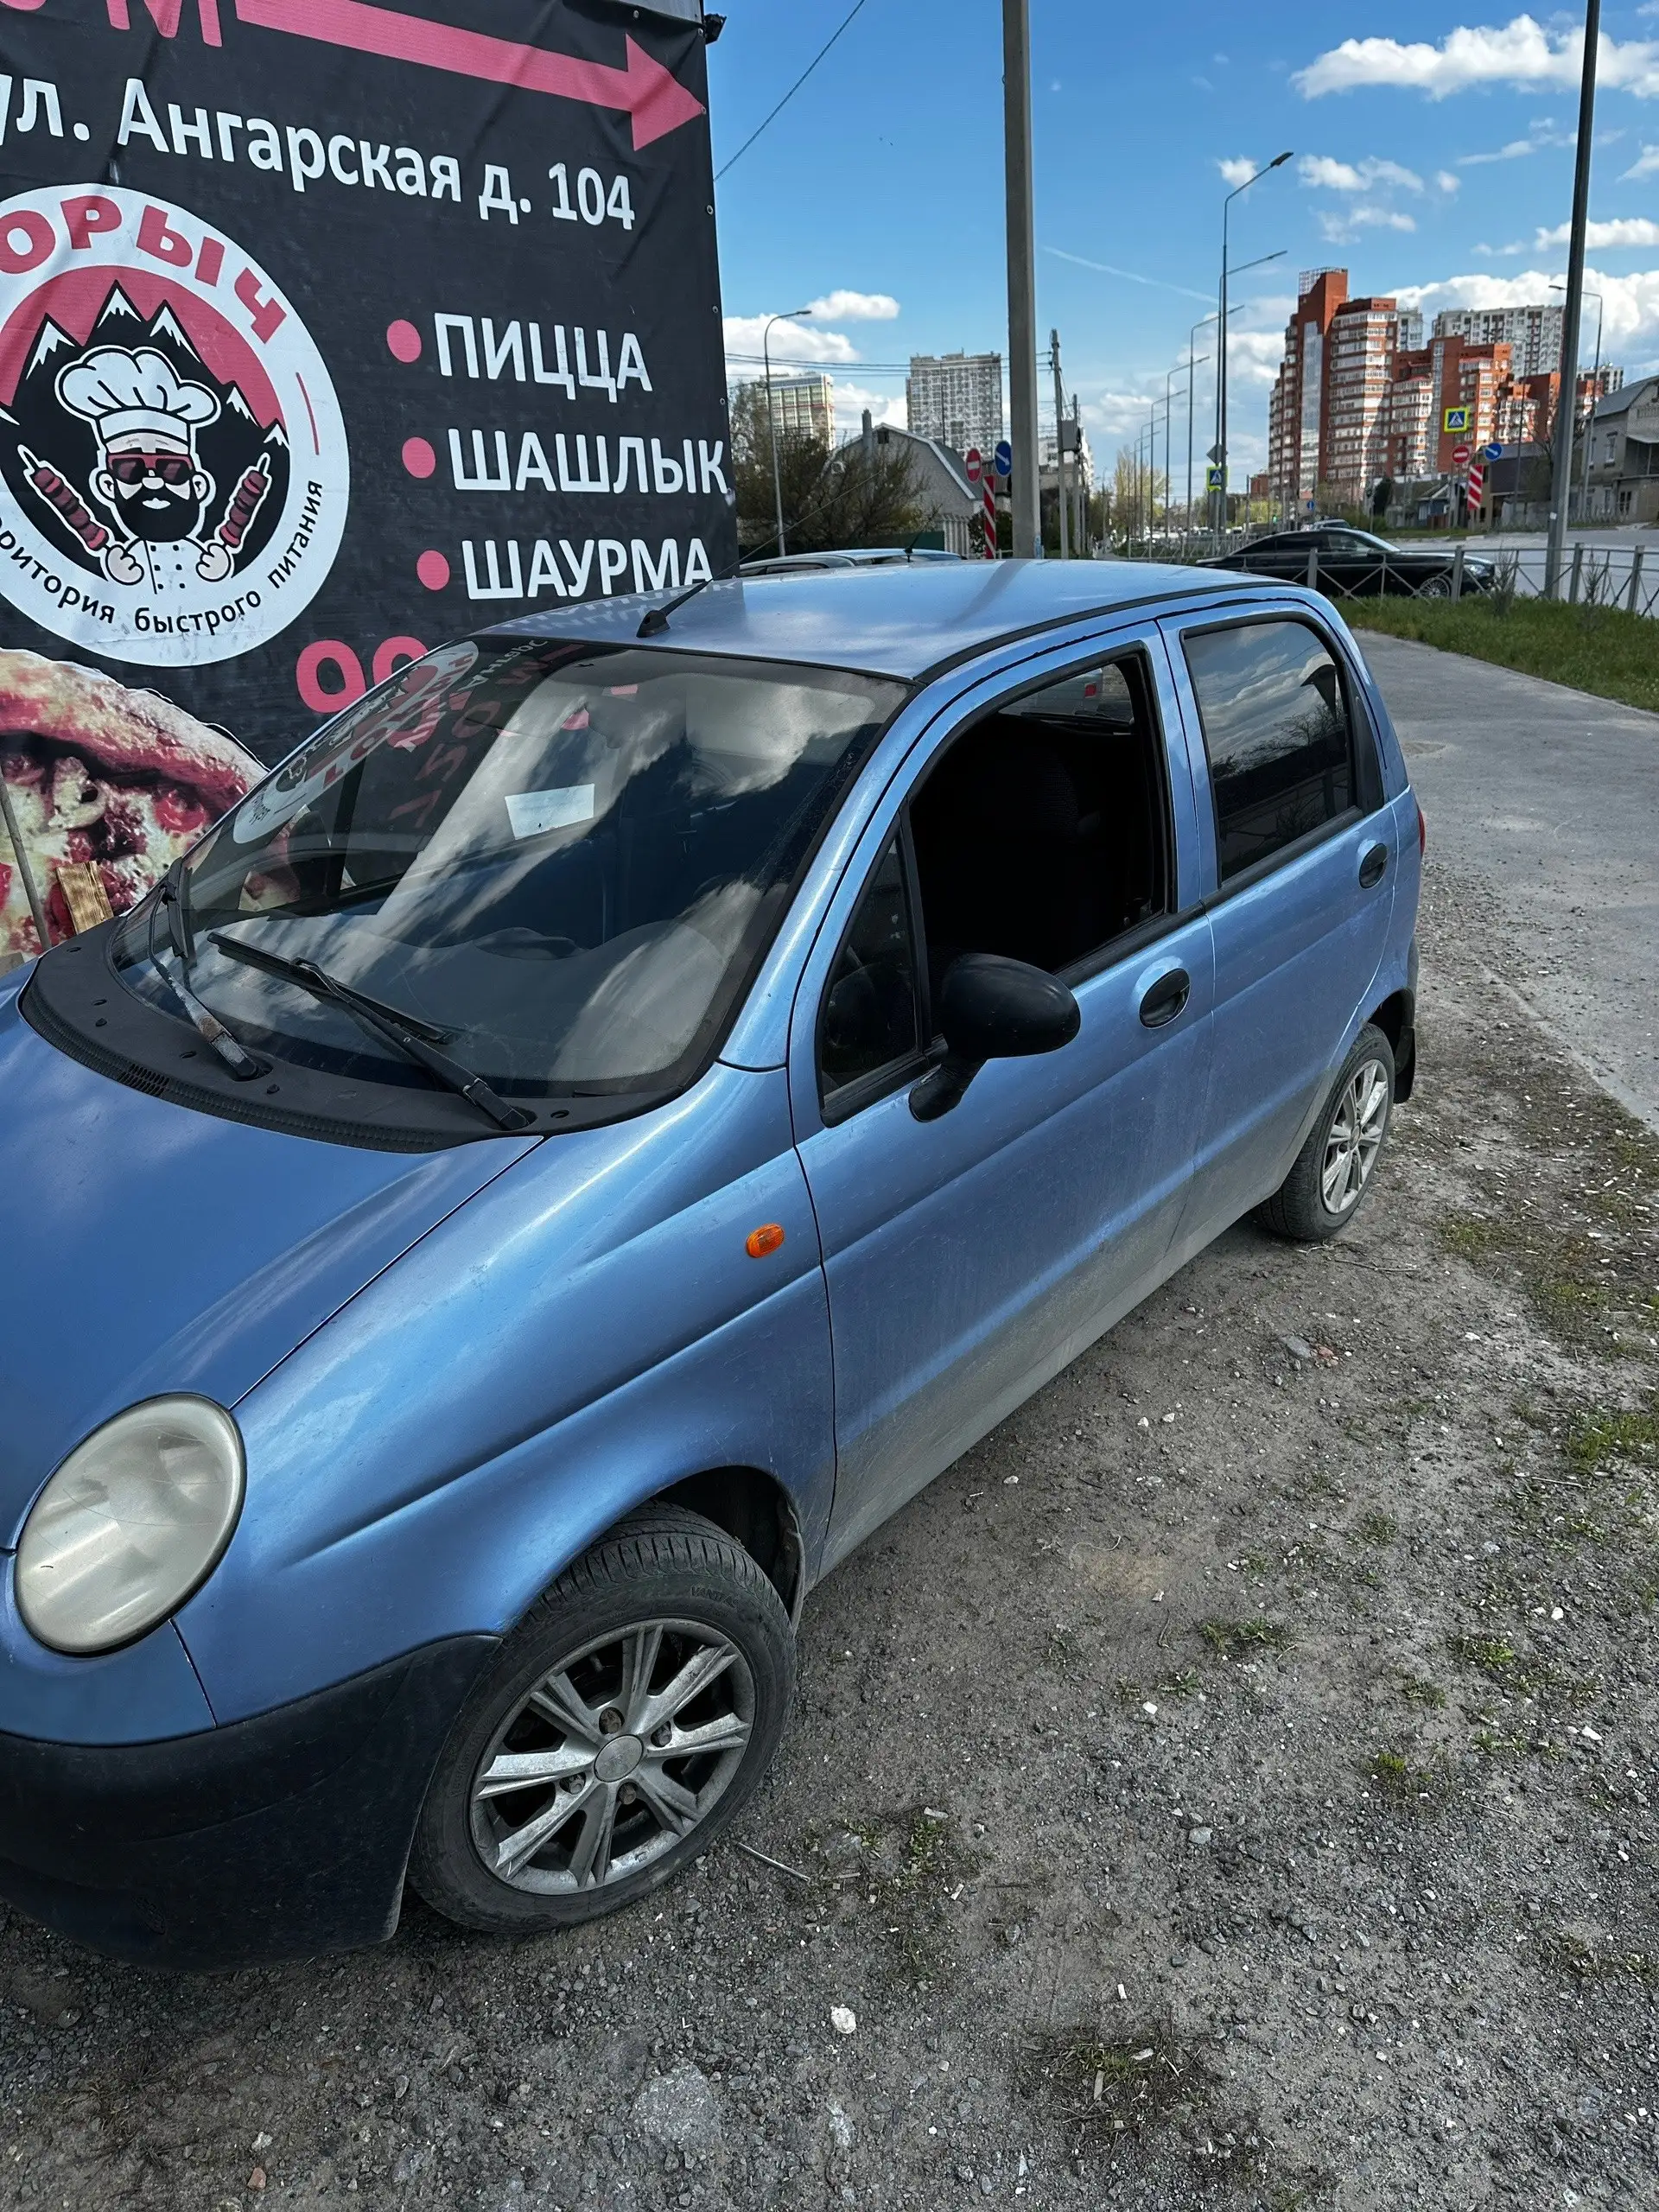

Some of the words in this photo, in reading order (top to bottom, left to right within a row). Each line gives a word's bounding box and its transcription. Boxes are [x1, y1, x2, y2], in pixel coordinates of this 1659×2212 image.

[117, 78, 462, 202] Ангарская
[478, 163, 531, 225] д.
[548, 162, 635, 231] 104
[434, 312, 653, 404] ПИЦЦА
[448, 428, 728, 495] ШАШЛЫК
[0, 518, 116, 625] ритория
[135, 590, 262, 637] быстрого
[267, 480, 323, 589] питания
[461, 537, 714, 600] ШАУРМА
